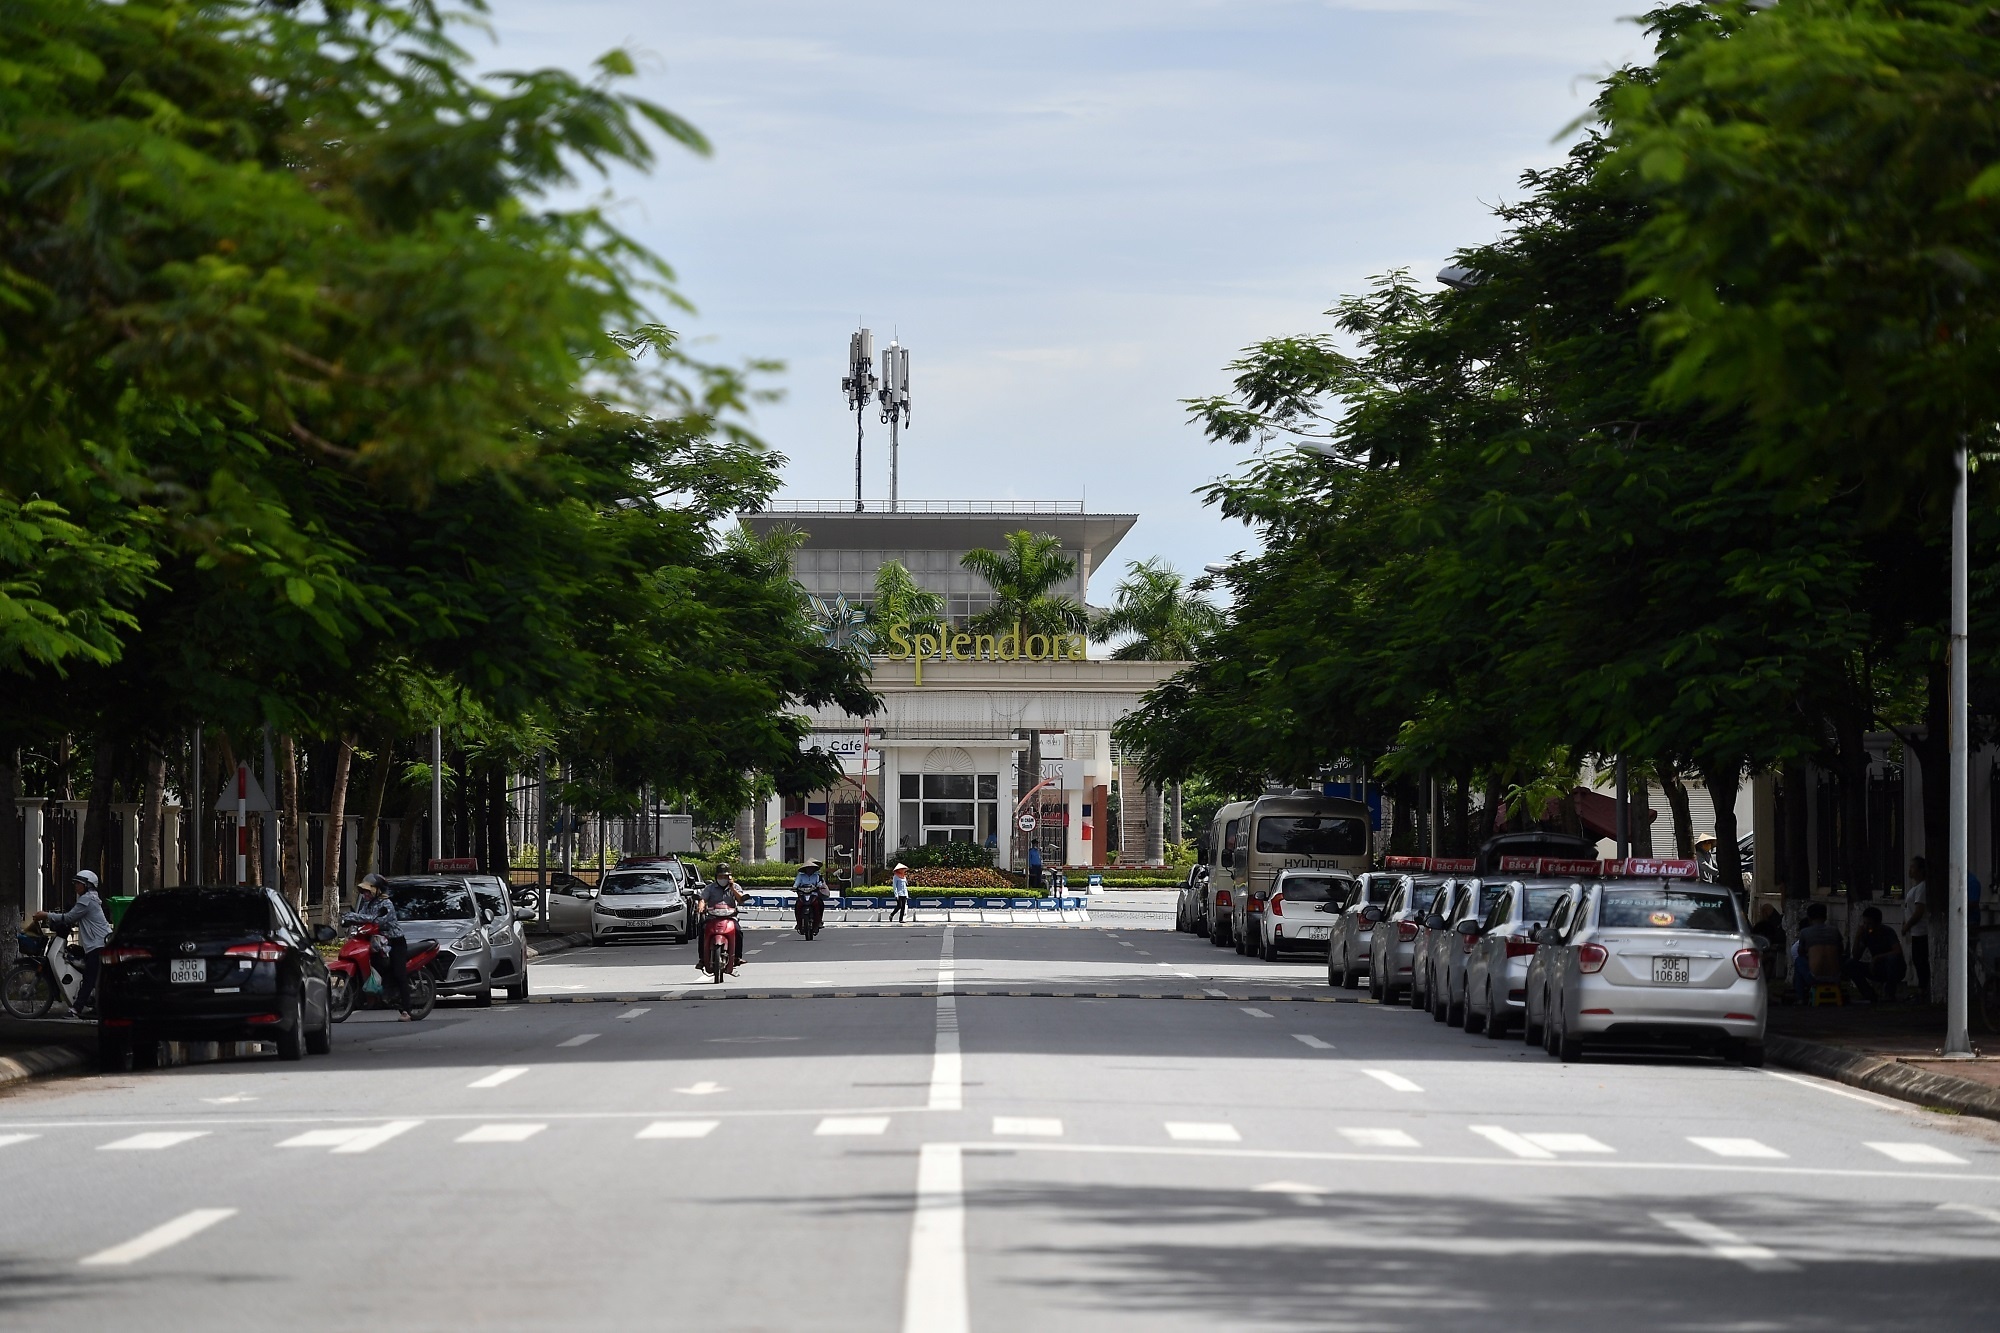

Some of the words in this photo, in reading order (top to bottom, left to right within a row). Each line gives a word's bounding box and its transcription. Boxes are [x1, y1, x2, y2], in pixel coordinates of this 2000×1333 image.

[888, 623, 1086, 687] Splendora
[831, 739, 862, 752] Café
[1284, 858, 1339, 870] HYUNDAI
[178, 959, 198, 971] 30G
[1661, 958, 1680, 971] 30E
[171, 970, 205, 981] 080.90
[1655, 970, 1688, 983] 106.88
